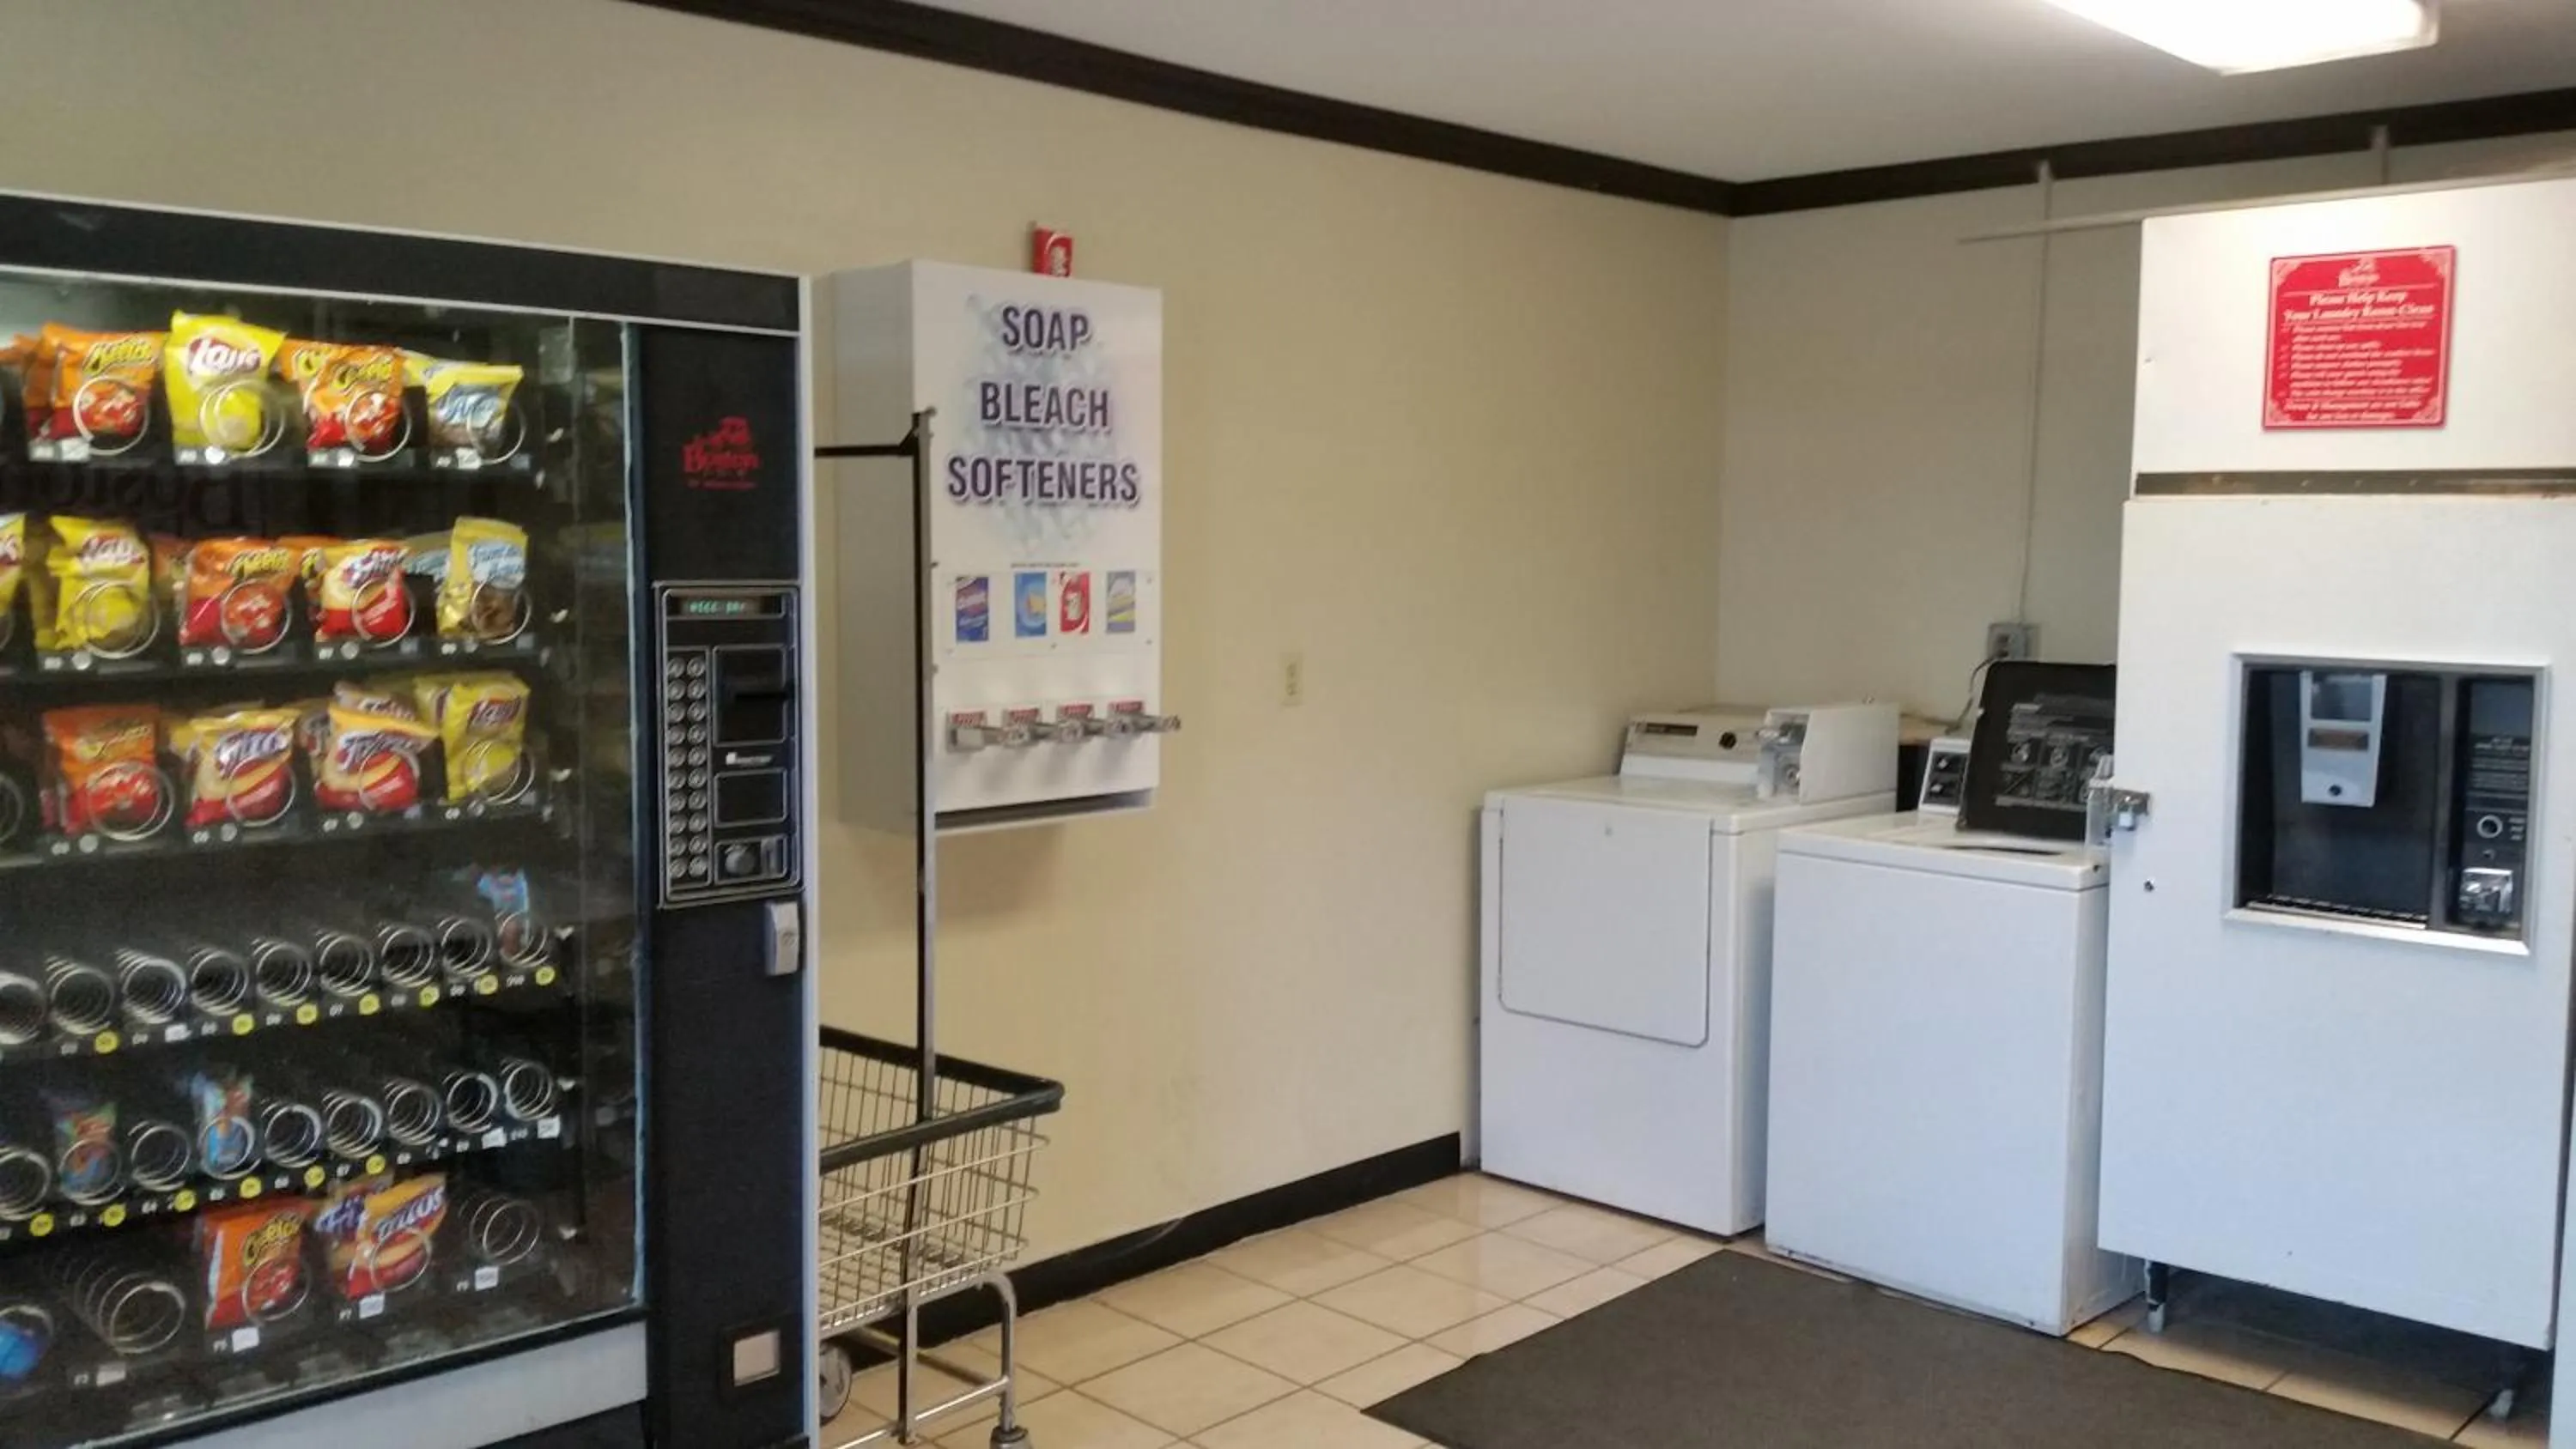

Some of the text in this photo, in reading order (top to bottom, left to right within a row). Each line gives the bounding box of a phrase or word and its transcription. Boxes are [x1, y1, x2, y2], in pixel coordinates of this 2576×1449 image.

[1002, 306, 1089, 351] SOAP
[980, 382, 1109, 427] BLEACH
[947, 457, 1139, 501] SOFTENERS
